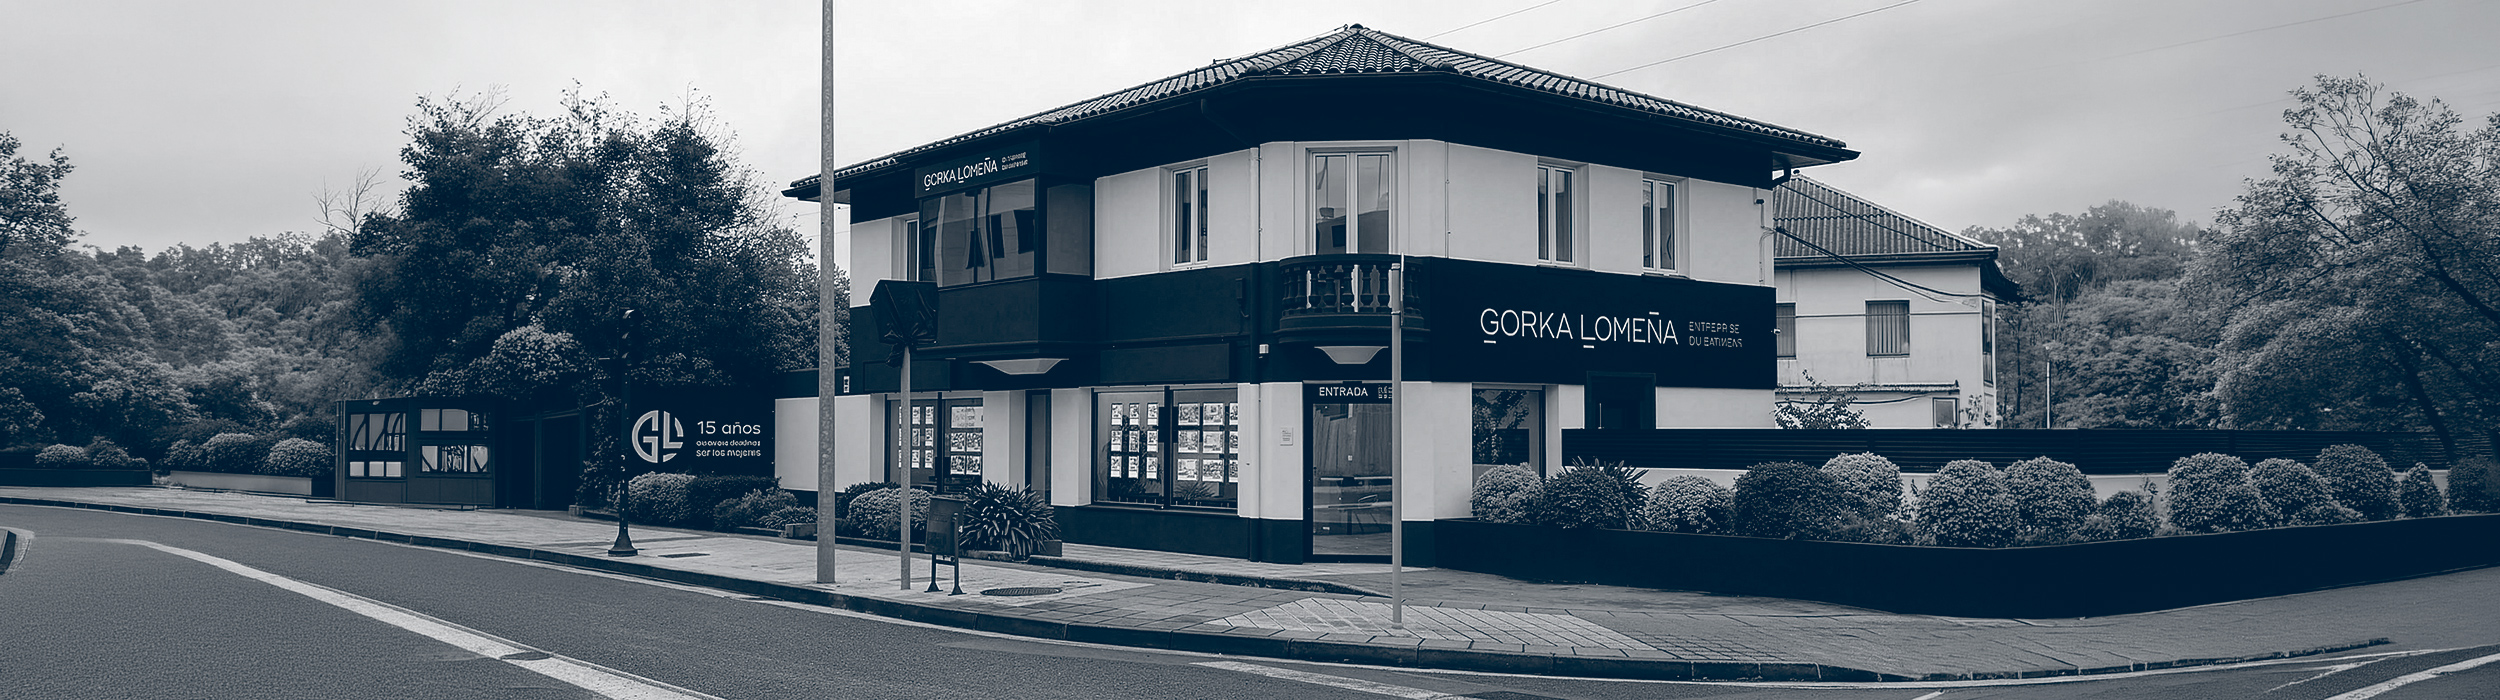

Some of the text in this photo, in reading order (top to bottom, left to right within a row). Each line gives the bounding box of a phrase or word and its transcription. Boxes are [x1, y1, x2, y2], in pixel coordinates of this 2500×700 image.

[923, 169, 957, 191] GORKA
[957, 157, 998, 184] LOMEÑA
[1480, 308, 1679, 349] GORKA LOMEÑA
[1319, 386, 1369, 397] ENTRADA
[697, 420, 761, 435] 15 años
